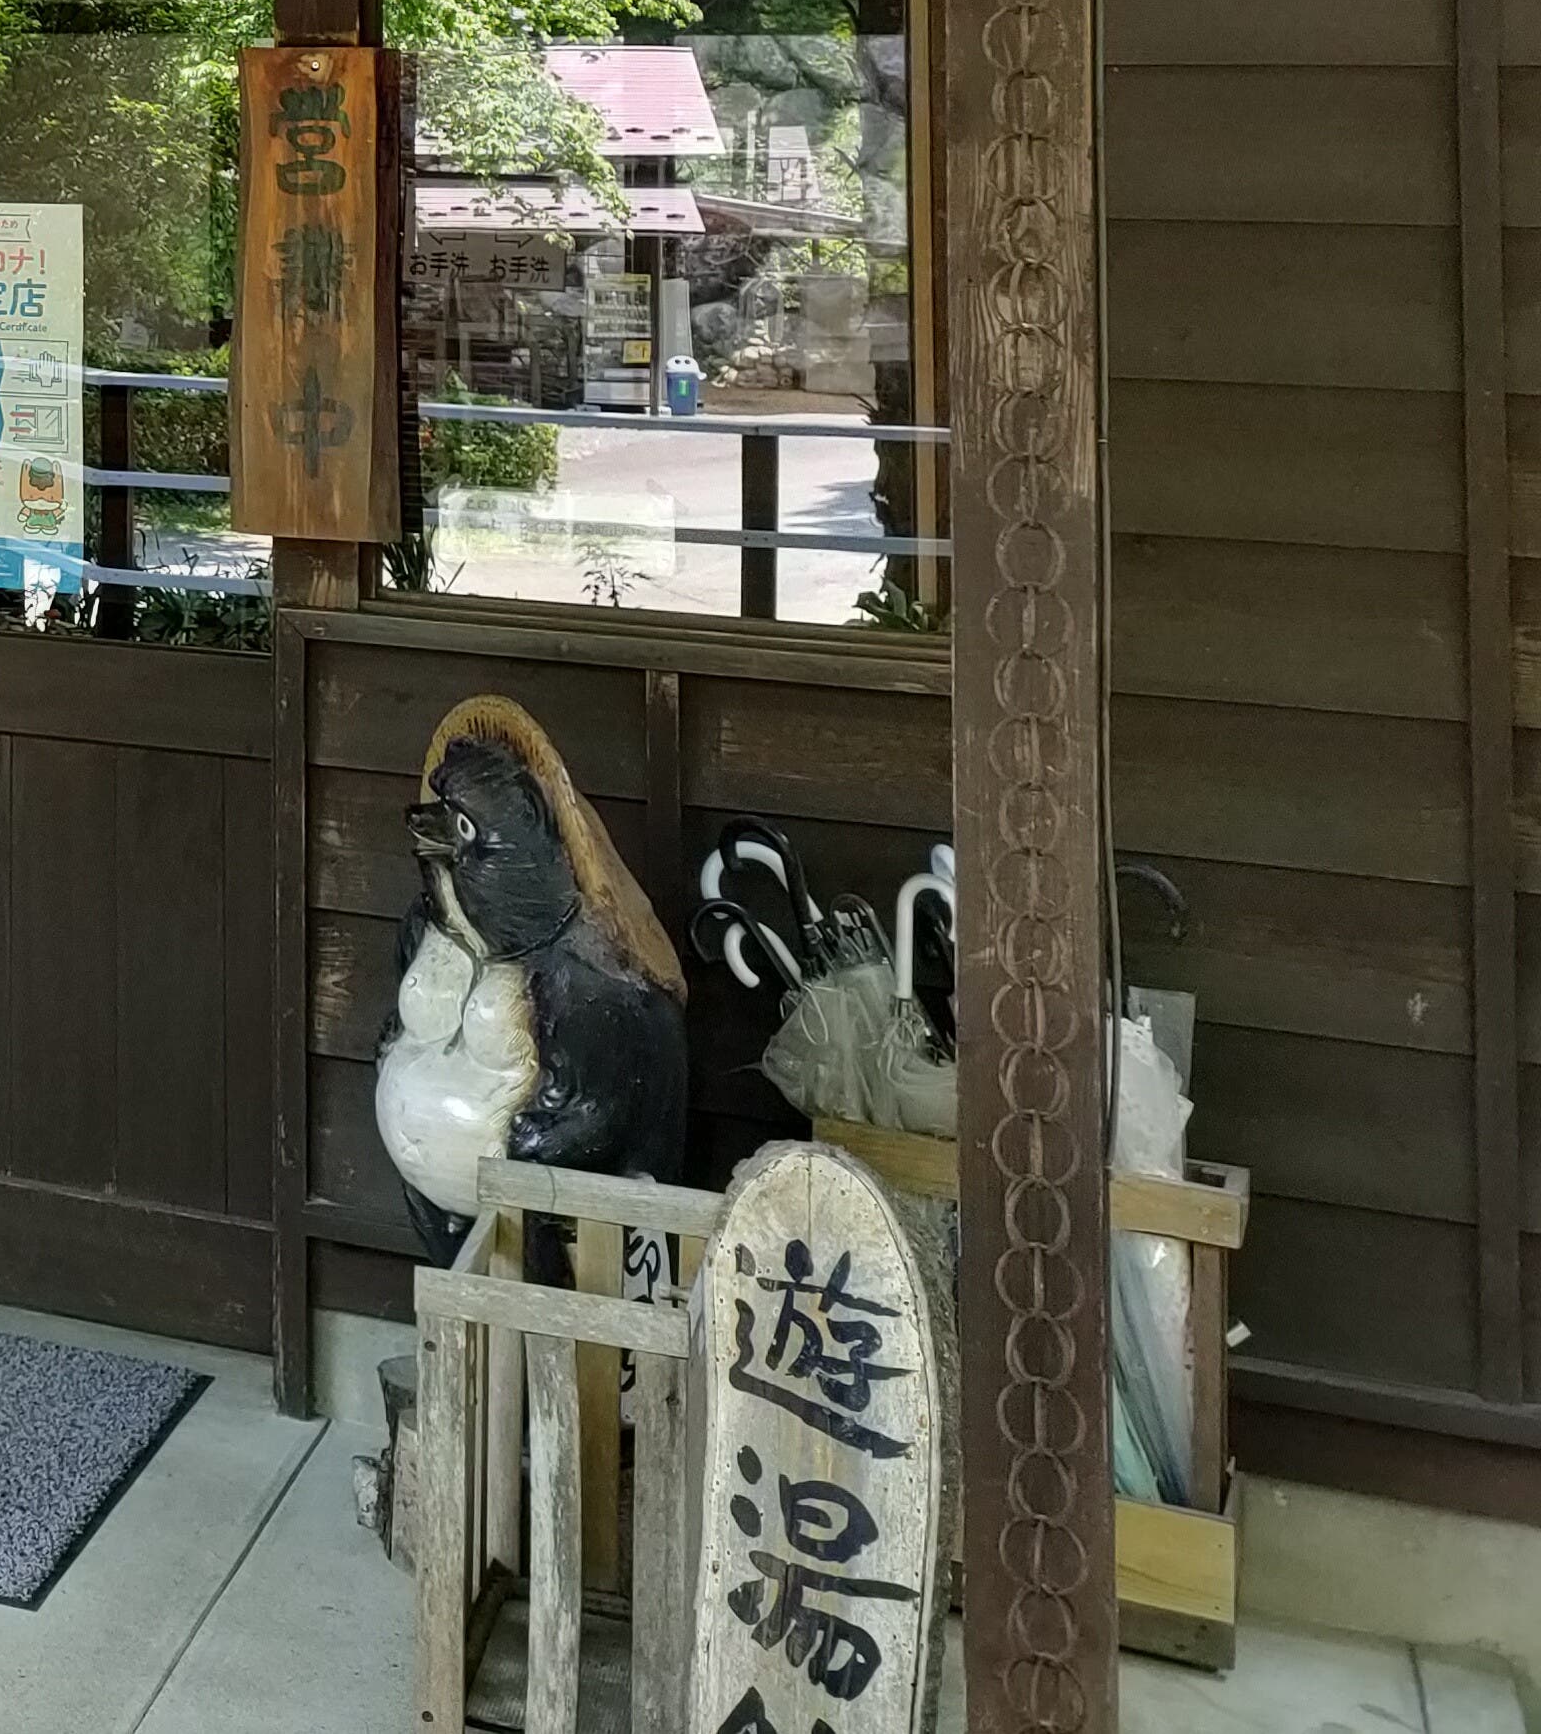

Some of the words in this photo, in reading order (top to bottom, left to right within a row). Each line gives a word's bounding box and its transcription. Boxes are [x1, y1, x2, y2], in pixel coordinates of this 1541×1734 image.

[409, 251, 470, 279] お手洗
[489, 254, 550, 284] お手洗
[728, 1238, 920, 1734] 遊湯
